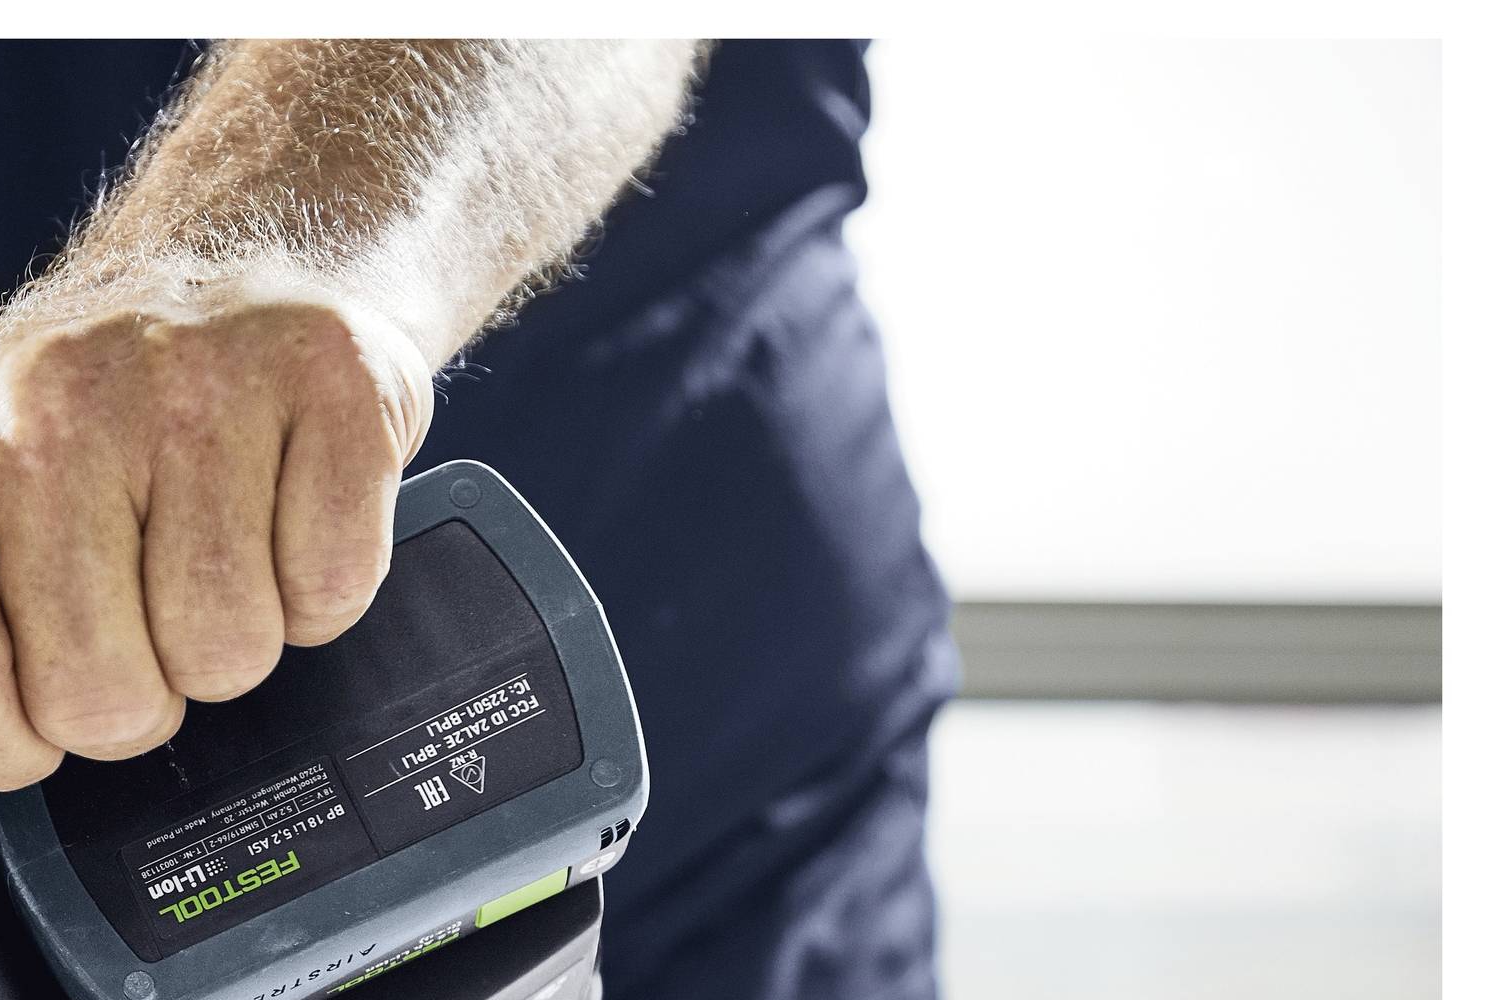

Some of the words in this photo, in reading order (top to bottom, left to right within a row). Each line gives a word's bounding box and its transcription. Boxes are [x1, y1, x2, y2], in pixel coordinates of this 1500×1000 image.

[507, 678, 532, 695] IC:
[425, 688, 509, 738] 22501-BPLI
[507, 694, 540, 718] FCC
[490, 709, 509, 726] ID
[442, 717, 491, 750] 2AL2E
[401, 743, 442, 770] -BPLI
[448, 748, 479, 770] R-NZ
[298, 763, 324, 780] 73240
[251, 775, 300, 800] Wendlingen
[296, 771, 328, 791] Festool
[272, 785, 298, 802] GmbH
[316, 791, 324, 800] V
[322, 786, 334, 796] 18
[211, 798, 248, 819] Germany
[238, 799, 270, 817] Wertstr.
[266, 811, 279, 821] Ah
[326, 803, 346, 821] BP
[184, 816, 207, 831] Made
[223, 813, 235, 825] 20
[292, 820, 308, 836] Li
[306, 814, 325, 829] 18
[174, 826, 184, 835] in
[270, 828, 293, 845] 5,2
[146, 831, 176, 849] Poland
[247, 837, 270, 856] ASI
[182, 847, 203, 860] T-Nr.
[140, 857, 180, 880] 10031138
[147, 864, 207, 900] Li-Ion
[158, 850, 301, 924] FESTOOL
